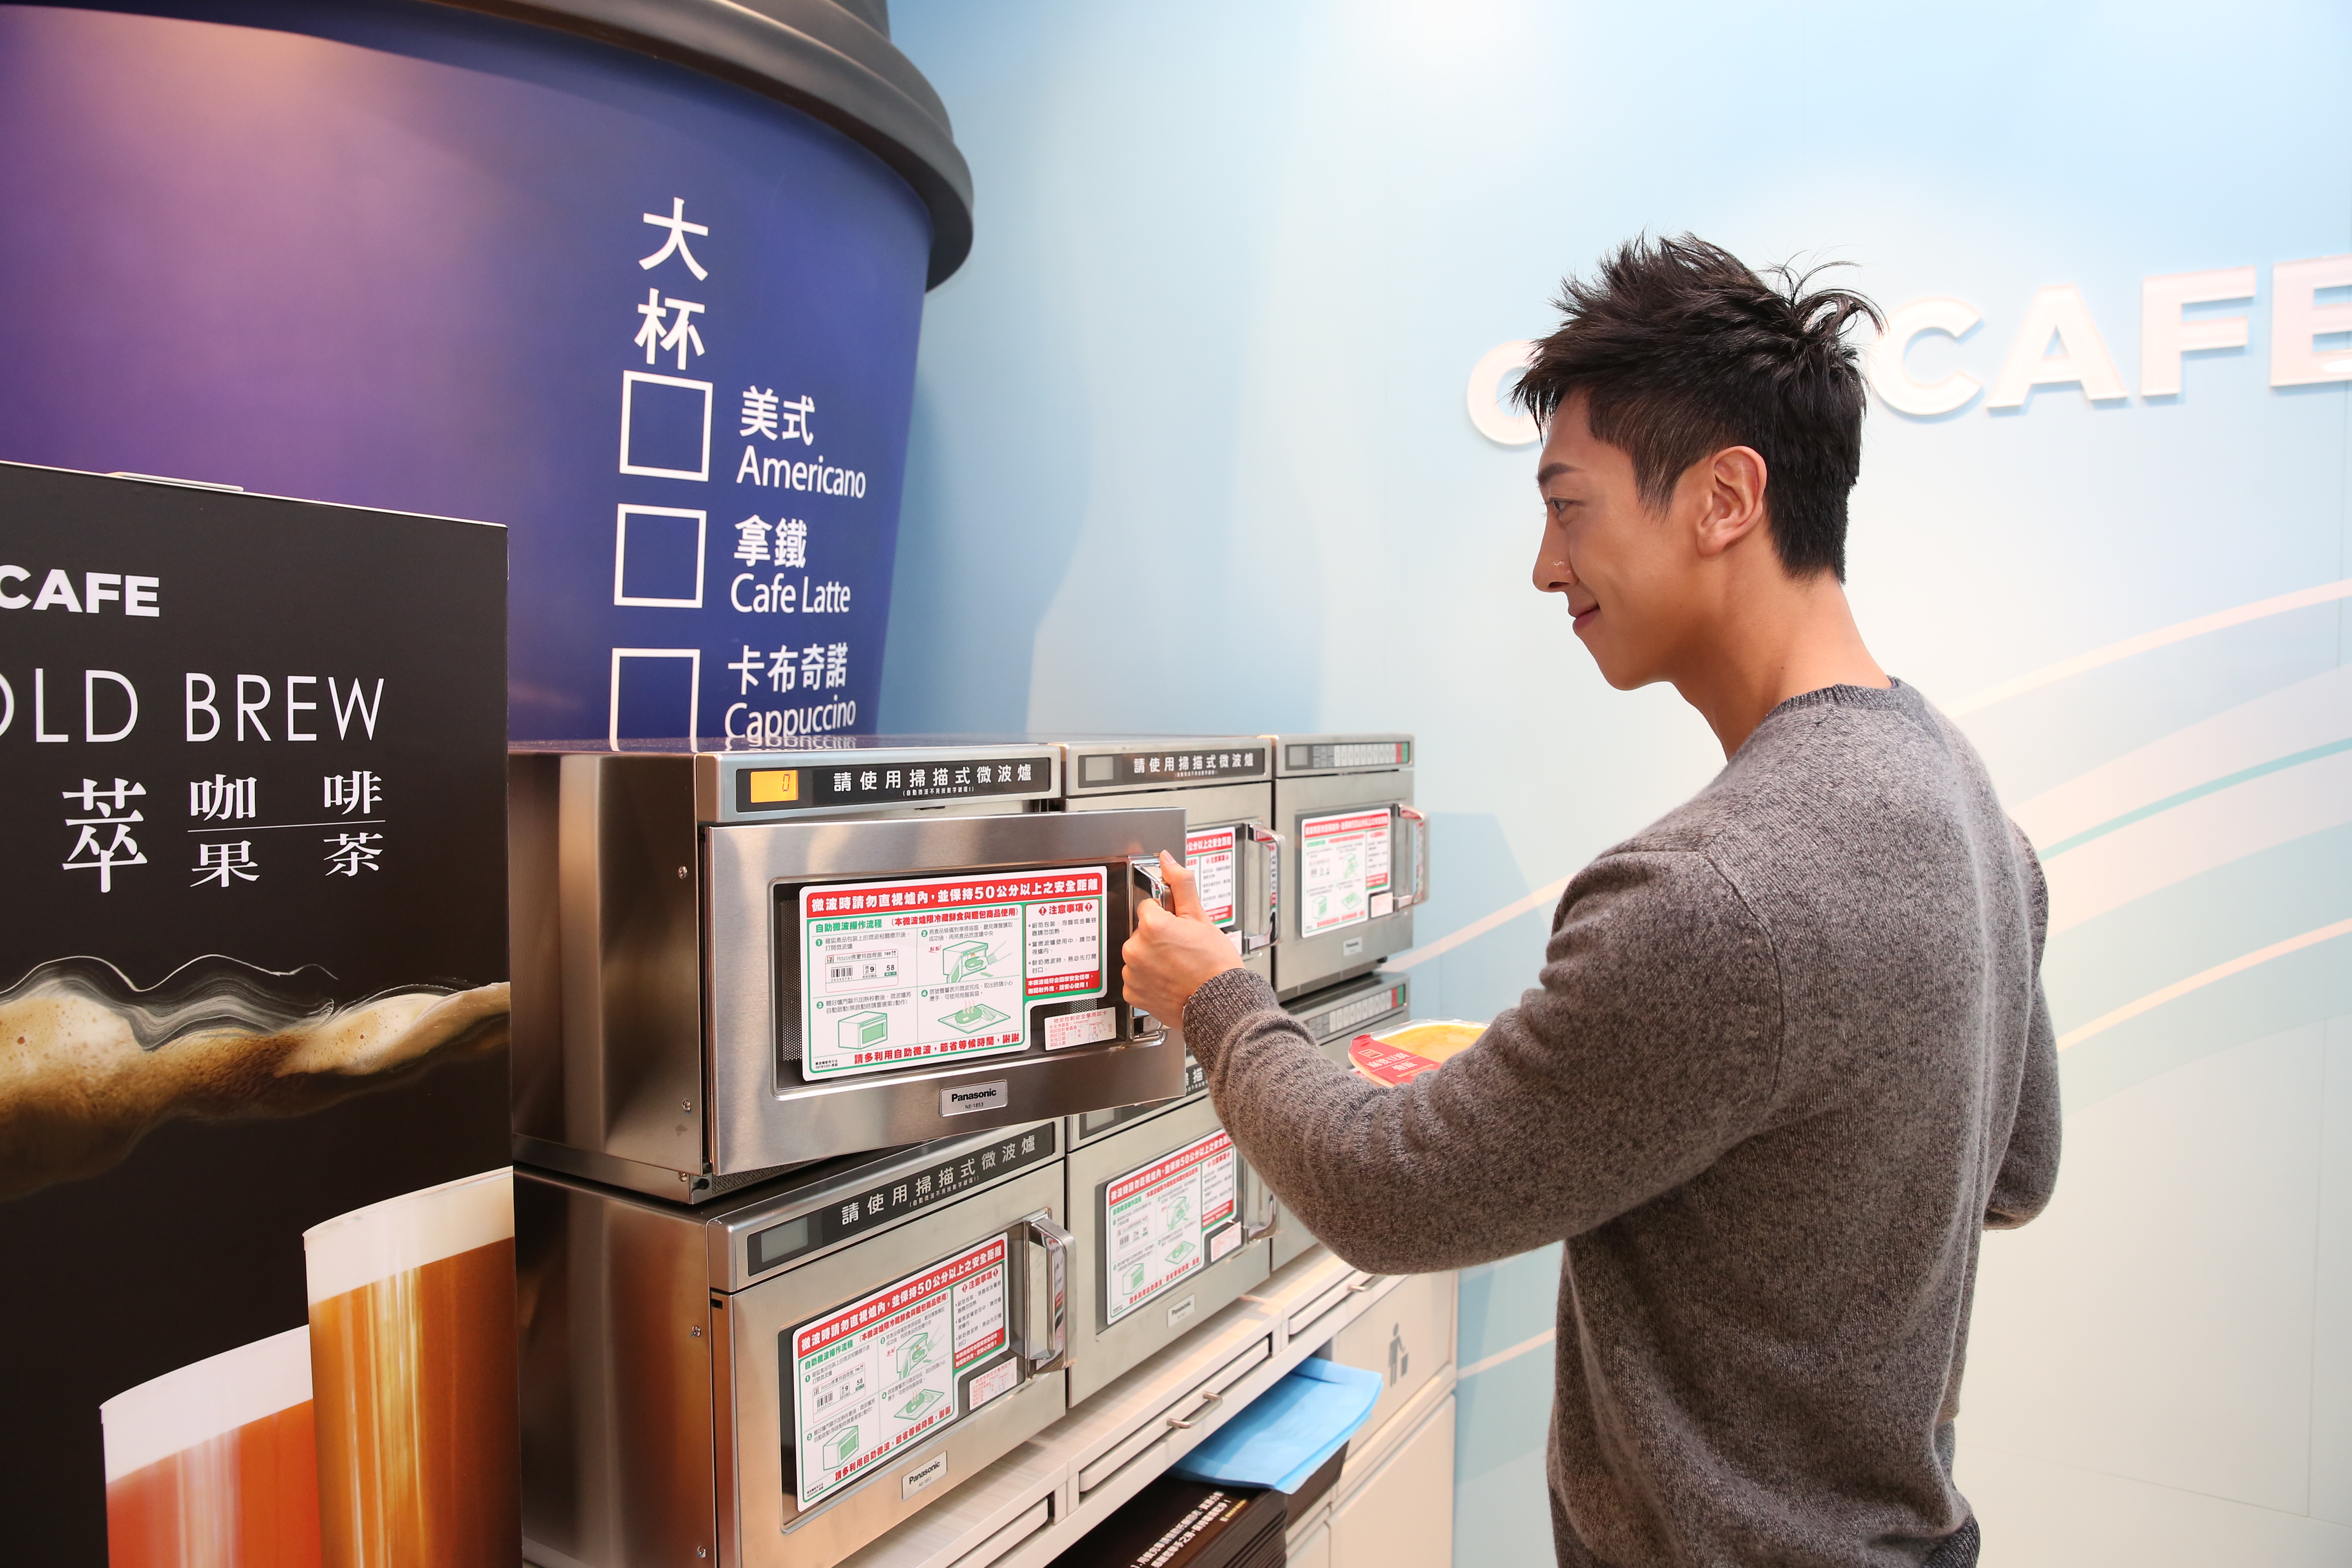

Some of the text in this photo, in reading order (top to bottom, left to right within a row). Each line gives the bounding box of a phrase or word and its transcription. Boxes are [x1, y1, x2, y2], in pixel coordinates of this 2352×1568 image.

[634, 197, 708, 370] 大杯
[1867, 253, 2352, 416] CAFE
[739, 385, 815, 445] 美式
[736, 445, 866, 499] Americano
[734, 514, 808, 568] 拿鐵
[0, 564, 160, 617] CAFE
[731, 573, 851, 613] Cafe Latte
[728, 642, 848, 696] 卡布奇諾
[0, 667, 384, 743] LD BREW
[724, 695, 856, 739] Cappuccino
[189, 770, 383, 821] 咖啡
[782, 773, 790, 792] 0
[833, 764, 1032, 792] 請使用掃描式微波爐
[62, 777, 148, 893] 萃
[189, 832, 383, 888] 果茶
[816, 919, 882, 933] 自助微波操作流程
[1049, 903, 1083, 914] 注意事項
[951, 1088, 997, 1102] Panasonic
[841, 1134, 1036, 1226] 請使用掃描式微波爐
[909, 1461, 940, 1485] Panasonic
